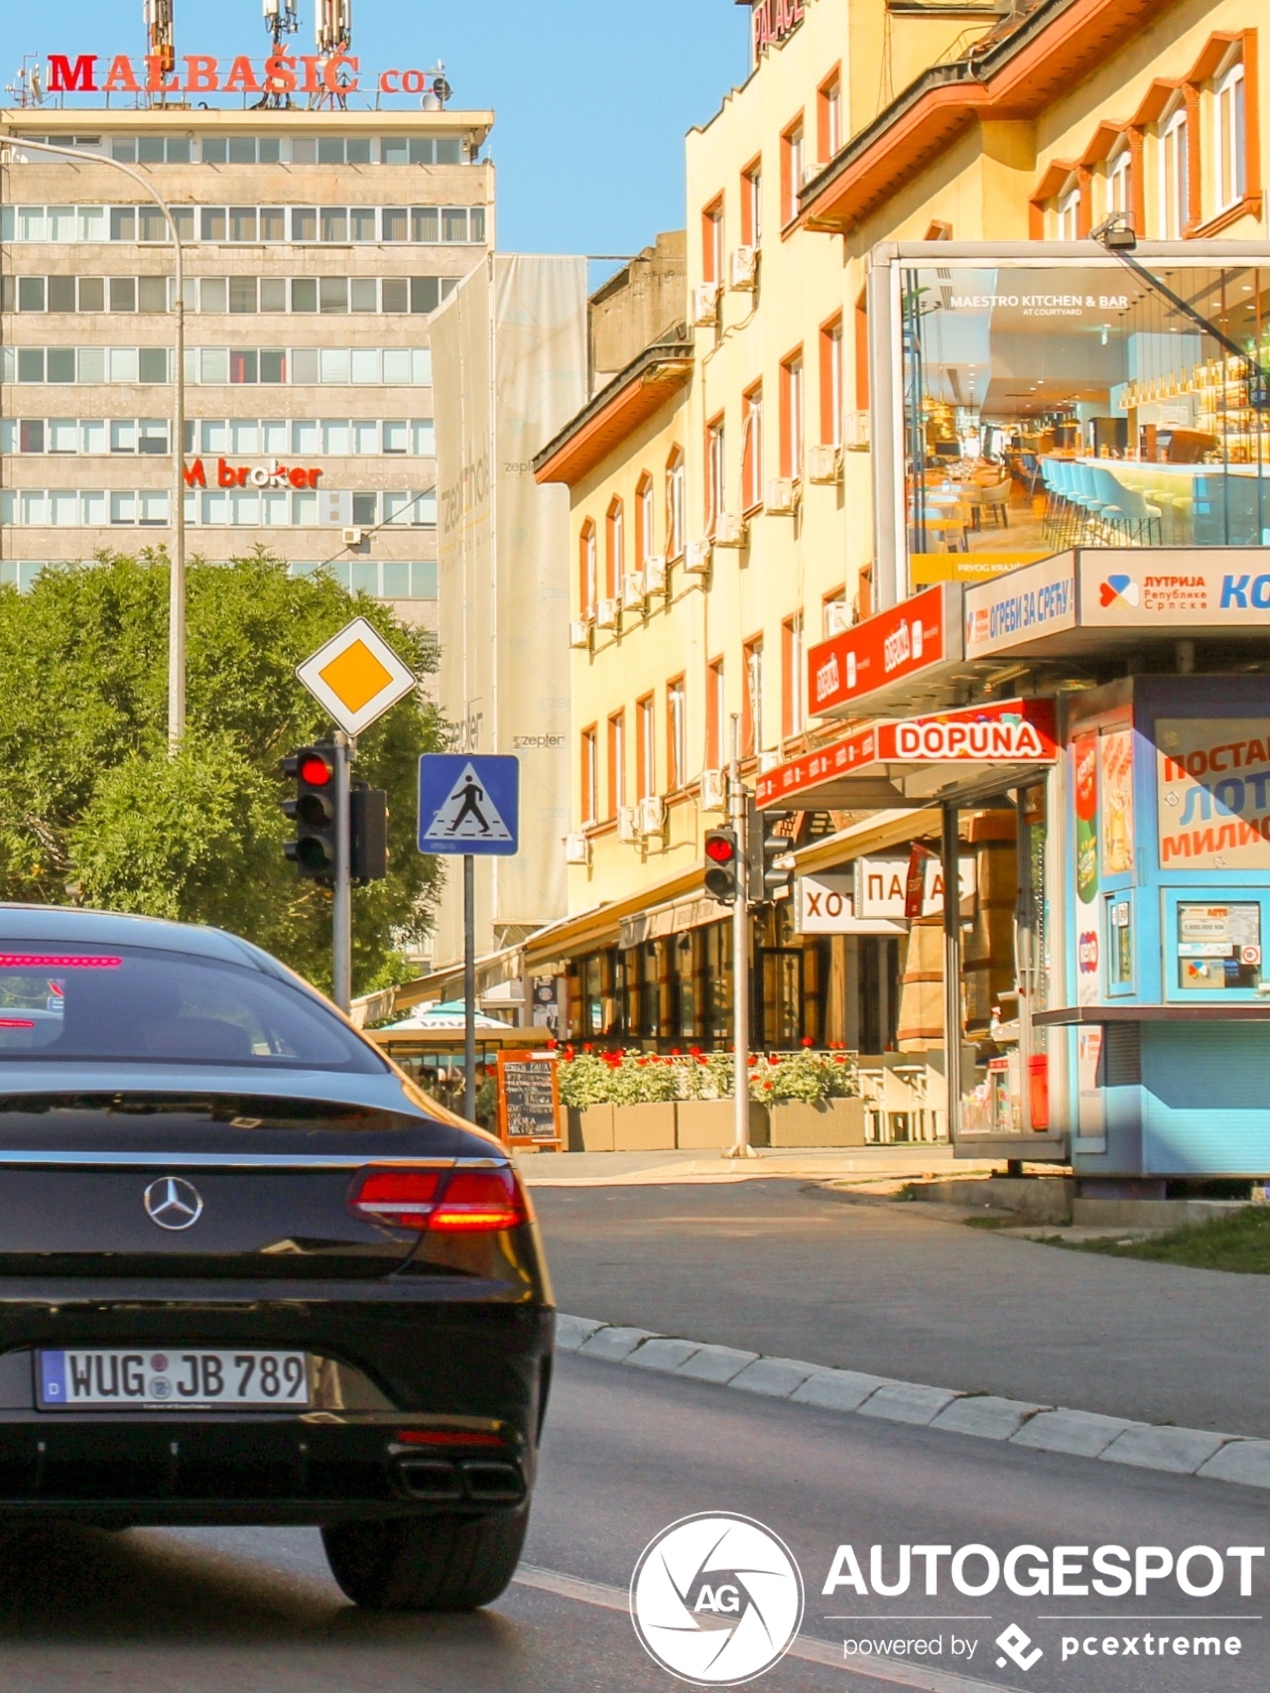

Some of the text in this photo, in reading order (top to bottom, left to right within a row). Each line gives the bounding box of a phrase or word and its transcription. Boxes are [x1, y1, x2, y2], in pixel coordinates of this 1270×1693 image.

[46, 43, 359, 93] MALBAŠIĆ
[950, 295, 1128, 308] MAESTRO KITCHEN & BAR
[1023, 308, 1083, 316] AT COURTYARD
[218, 457, 323, 488] broker
[957, 563, 990, 573] PRVOG
[1143, 576, 1206, 588] ЛУТРИЈА
[1144, 589, 1207, 601] Републике
[1144, 600, 1208, 611] Српске
[990, 594, 1022, 639] ОГРЕБИ
[1023, 591, 1036, 627] ЗА
[898, 724, 1039, 756] DOPUNA
[1164, 736, 1270, 783] ПОСТА
[48, 1355, 305, 1398] D WUG JB 789
